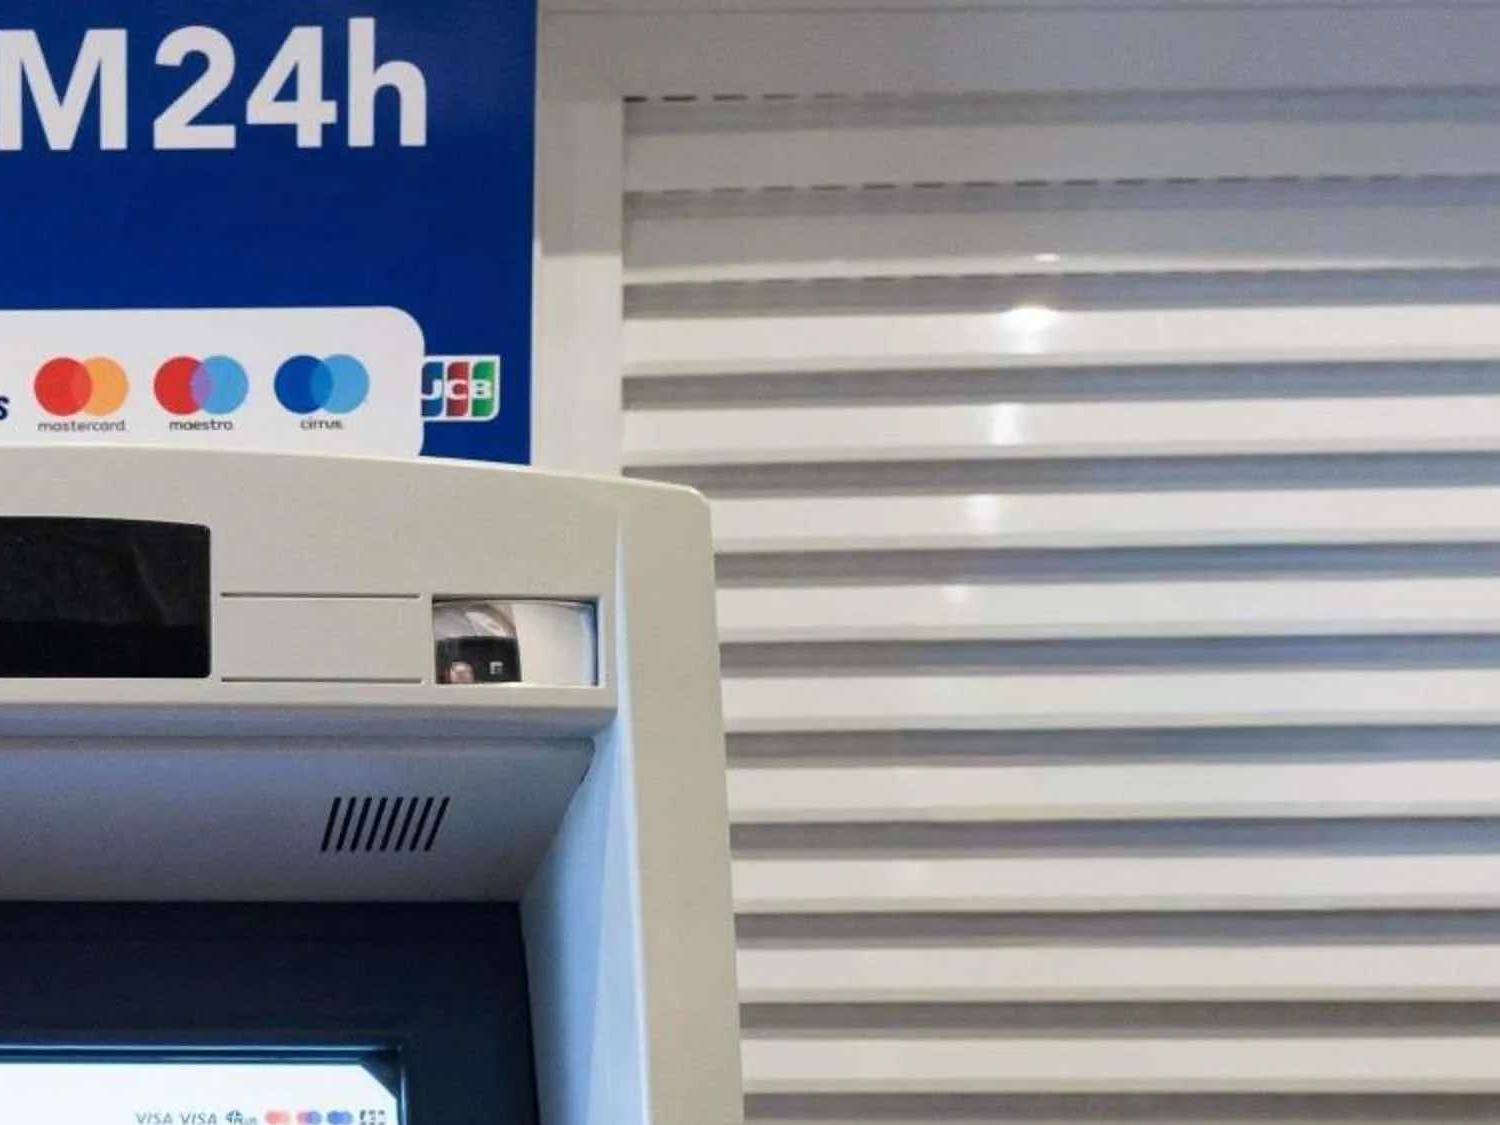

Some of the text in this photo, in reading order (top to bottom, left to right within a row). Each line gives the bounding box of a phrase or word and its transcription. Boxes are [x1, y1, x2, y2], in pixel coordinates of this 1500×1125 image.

[38, 419, 126, 432] mastercard
[169, 420, 233, 431] maestro
[299, 418, 343, 430] cirrus
[136, 1112, 174, 1125] VISA
